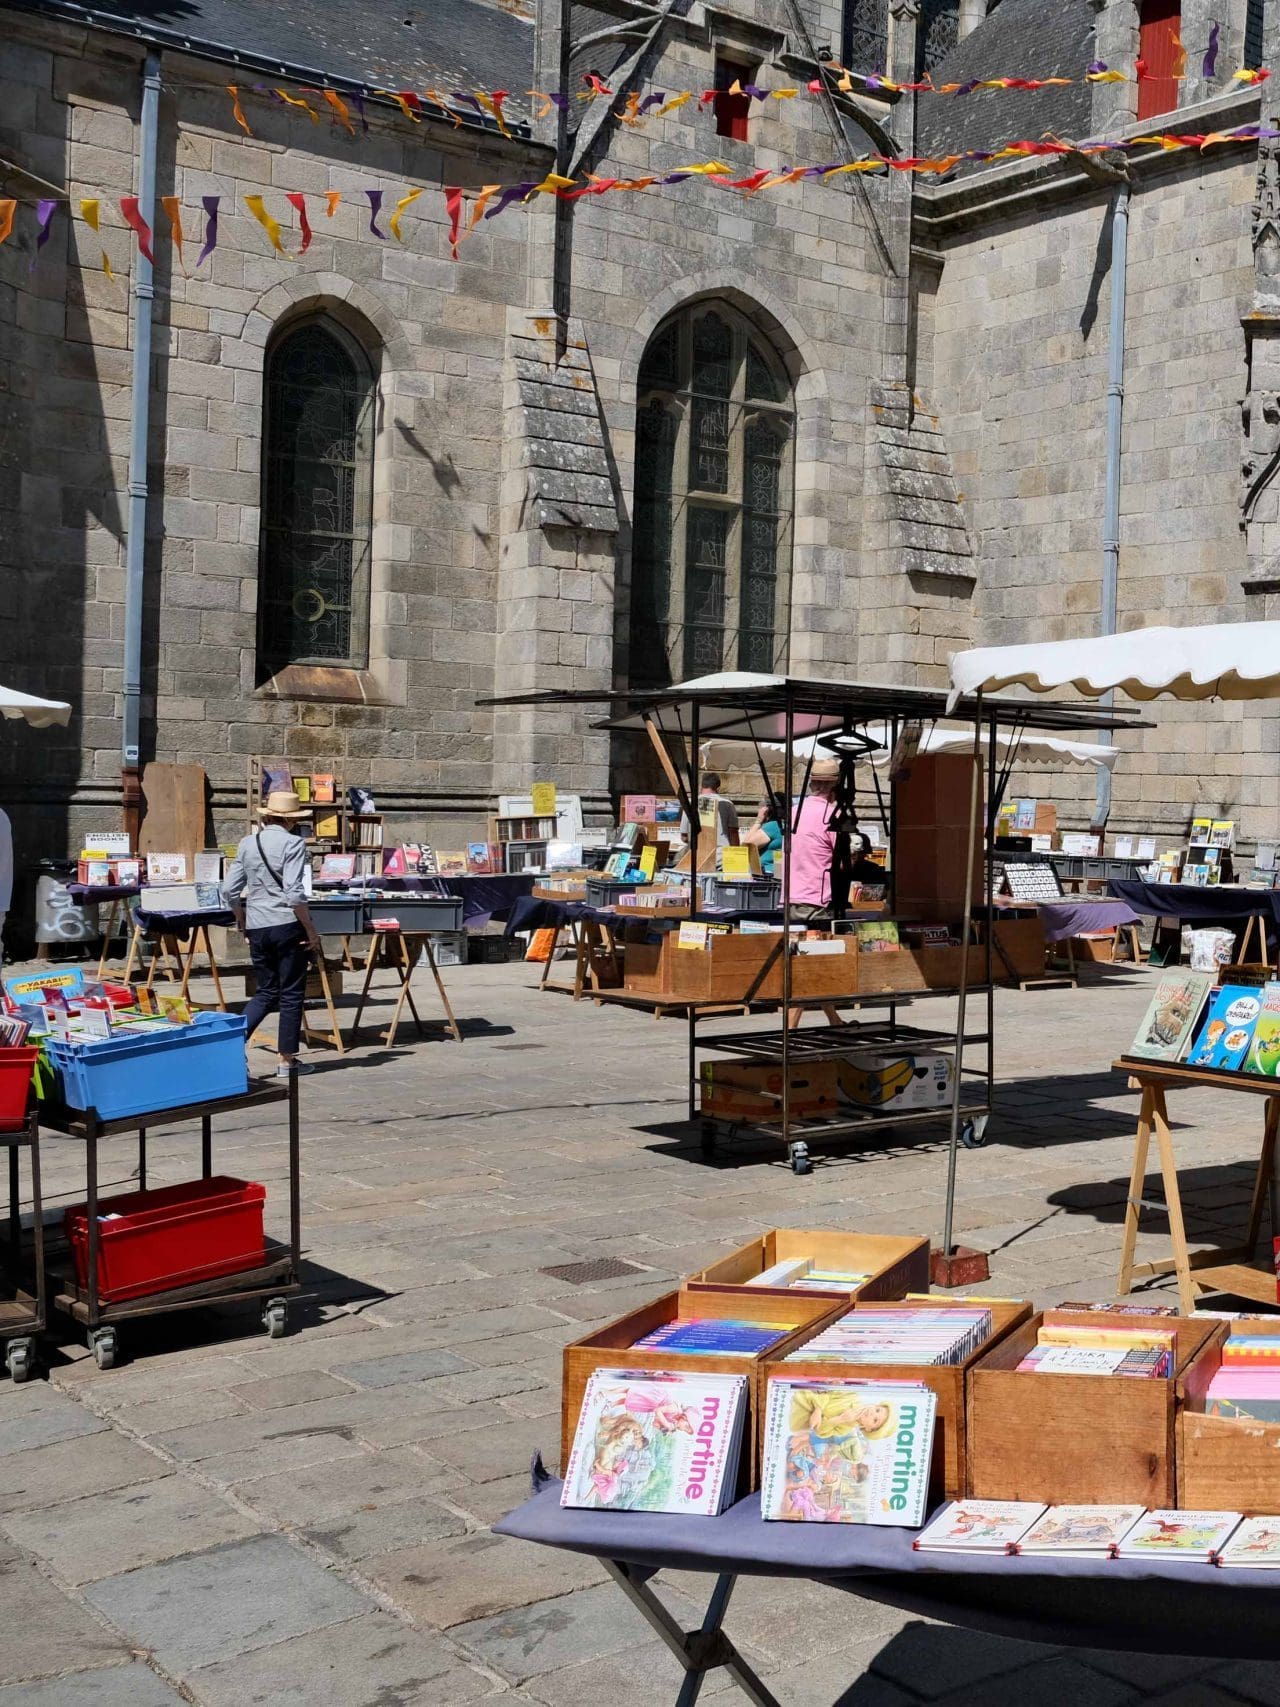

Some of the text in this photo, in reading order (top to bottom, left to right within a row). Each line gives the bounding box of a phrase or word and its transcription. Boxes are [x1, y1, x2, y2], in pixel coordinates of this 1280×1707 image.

[27, 976, 62, 986] YAKARI
[684, 1396, 721, 1501] martine
[888, 1404, 918, 1511] martine
